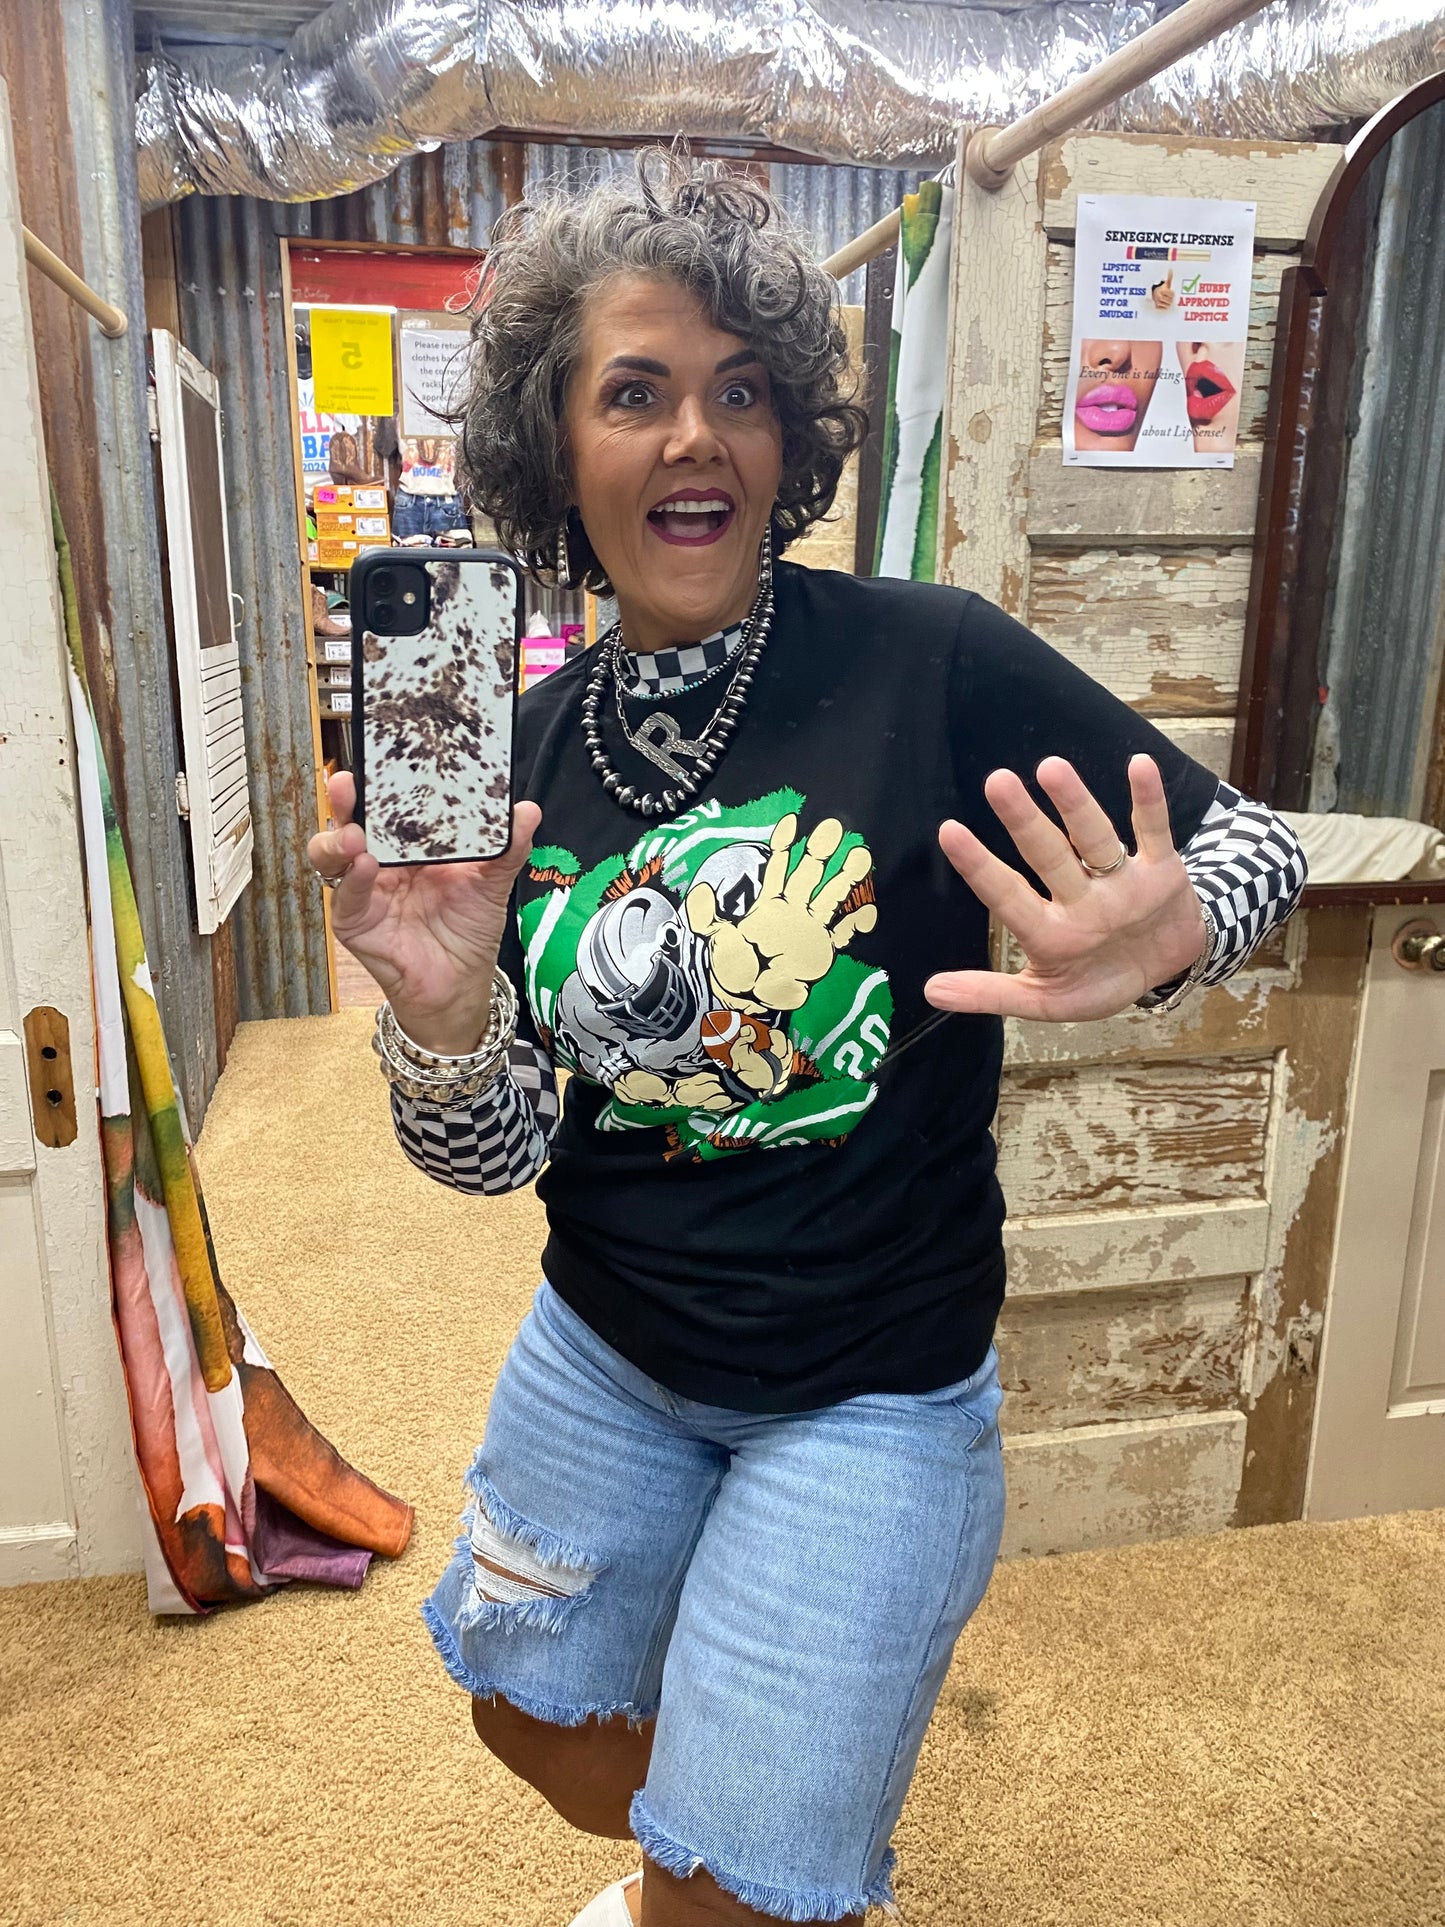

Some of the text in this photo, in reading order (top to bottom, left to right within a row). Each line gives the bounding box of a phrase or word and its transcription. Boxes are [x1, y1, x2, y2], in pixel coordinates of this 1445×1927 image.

[1105, 230, 1234, 246] SENEGENCE LIPSENSE
[1102, 262, 1141, 271] LIPSTICK
[1102, 274, 1124, 283] THAT
[1129, 287, 1146, 296] KISS
[1198, 283, 1231, 293] HUBBY
[1100, 298, 1128, 307] OFF OR
[1177, 296, 1230, 307] APPROVED
[1099, 309, 1133, 318] SMUDGE
[1184, 311, 1229, 322] LIPSTICK
[414, 341, 440, 349] Please
[412, 354, 439, 362] clothes
[420, 367, 434, 375] the
[1079, 366, 1109, 383] Every
[1112, 370, 1129, 380] one
[1132, 368, 1141, 380] is
[1141, 426, 1226, 441] about LipSense!
[412, 466, 443, 478] HOME
